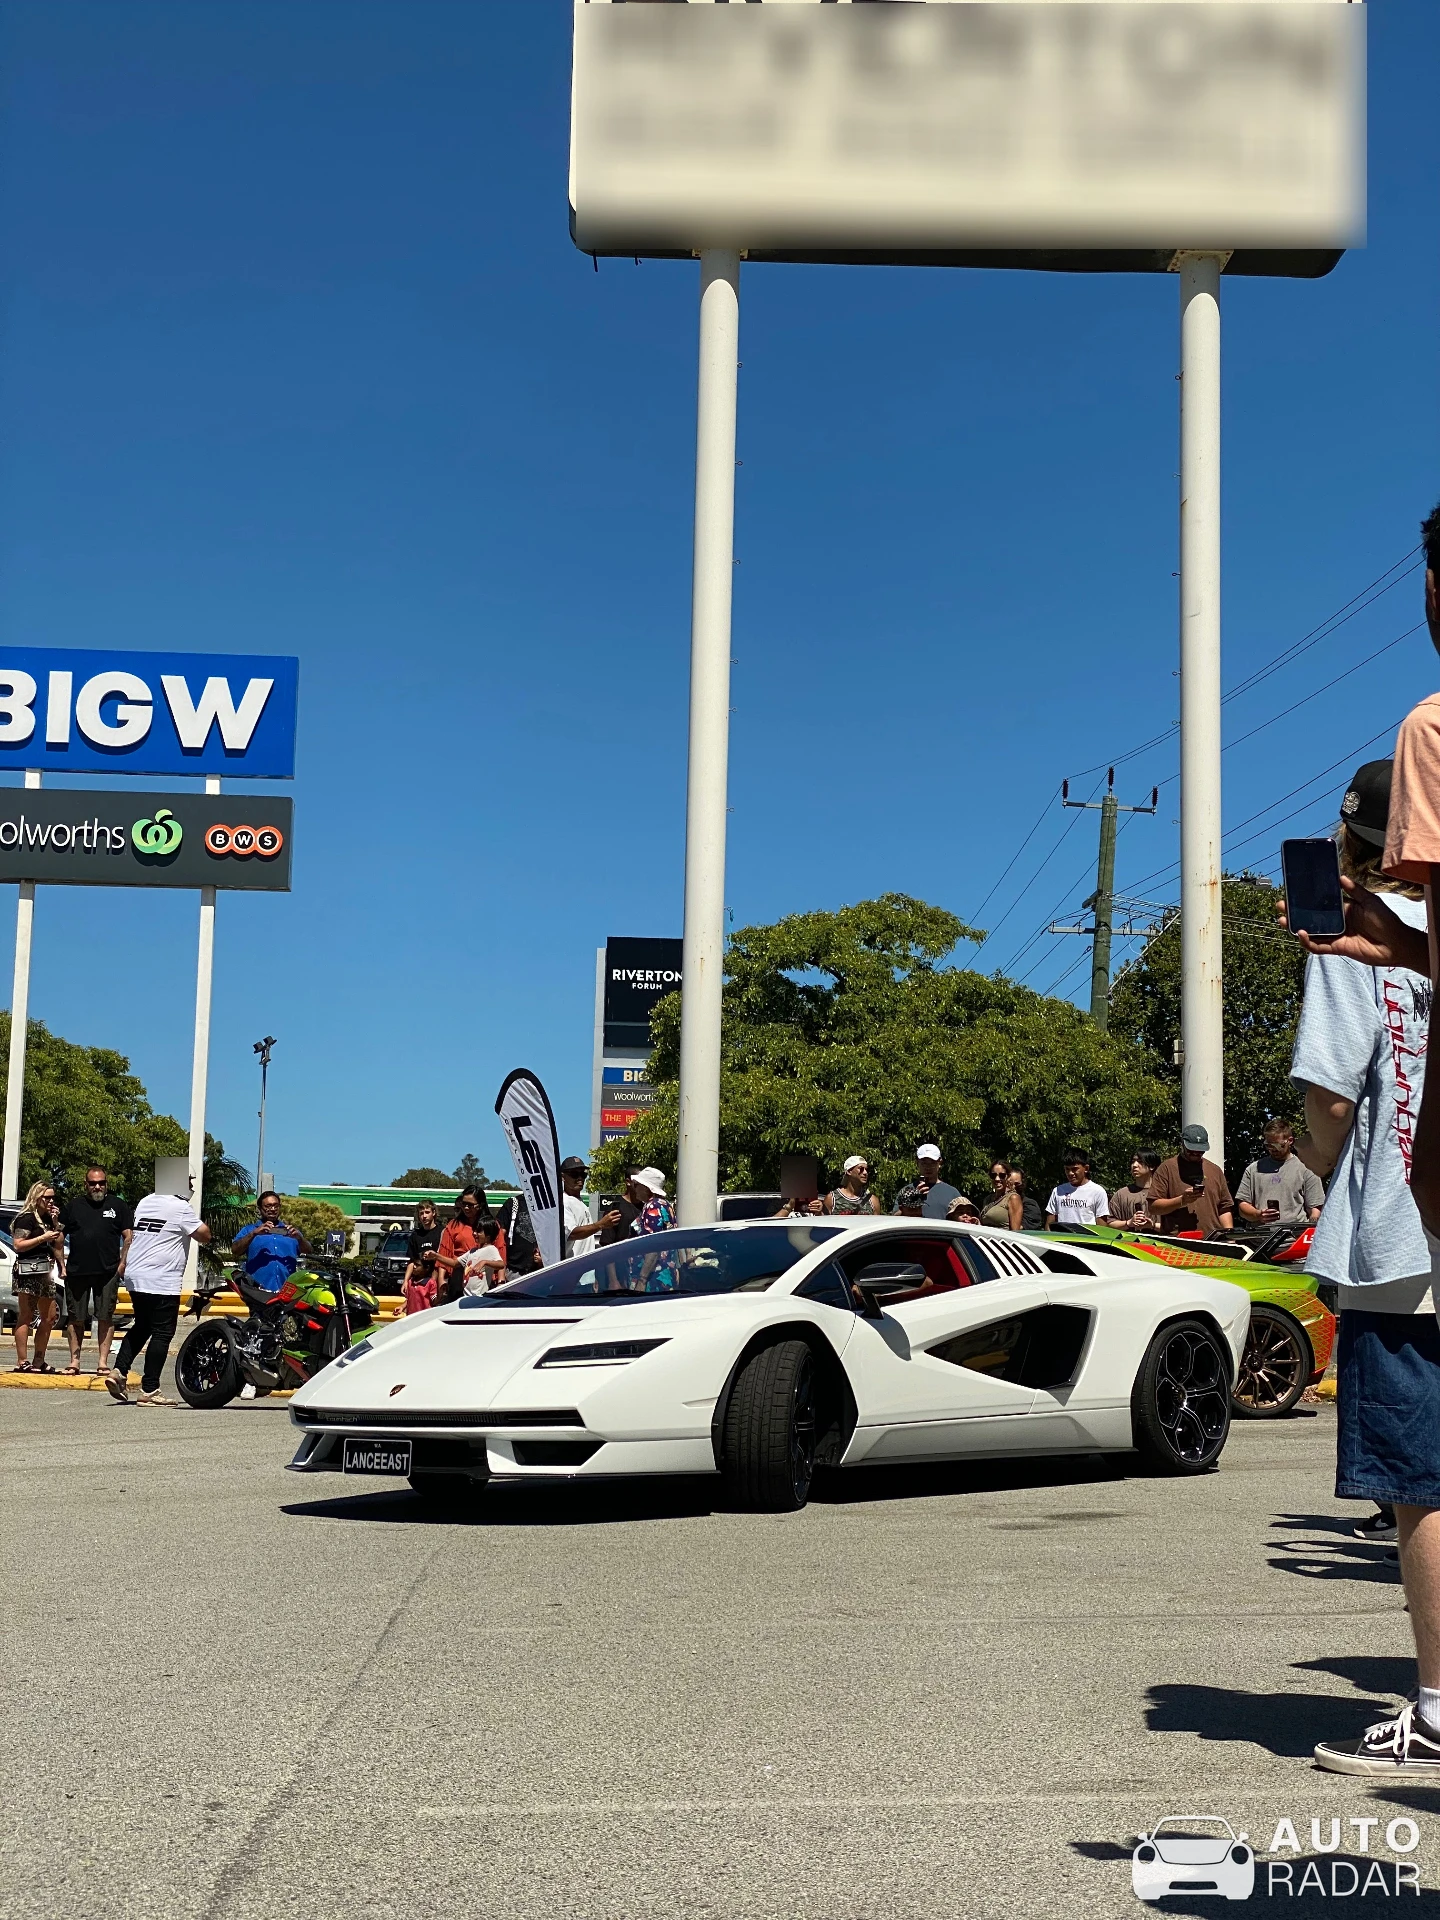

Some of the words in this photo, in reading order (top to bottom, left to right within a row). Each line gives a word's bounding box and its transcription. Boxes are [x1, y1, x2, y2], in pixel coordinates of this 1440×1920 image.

[215, 833, 273, 847] BWS
[612, 968, 683, 982] RIVERTON
[632, 982, 663, 990] FORUM
[605, 1113, 622, 1122] THE
[345, 1451, 410, 1471] LANCEEAST
